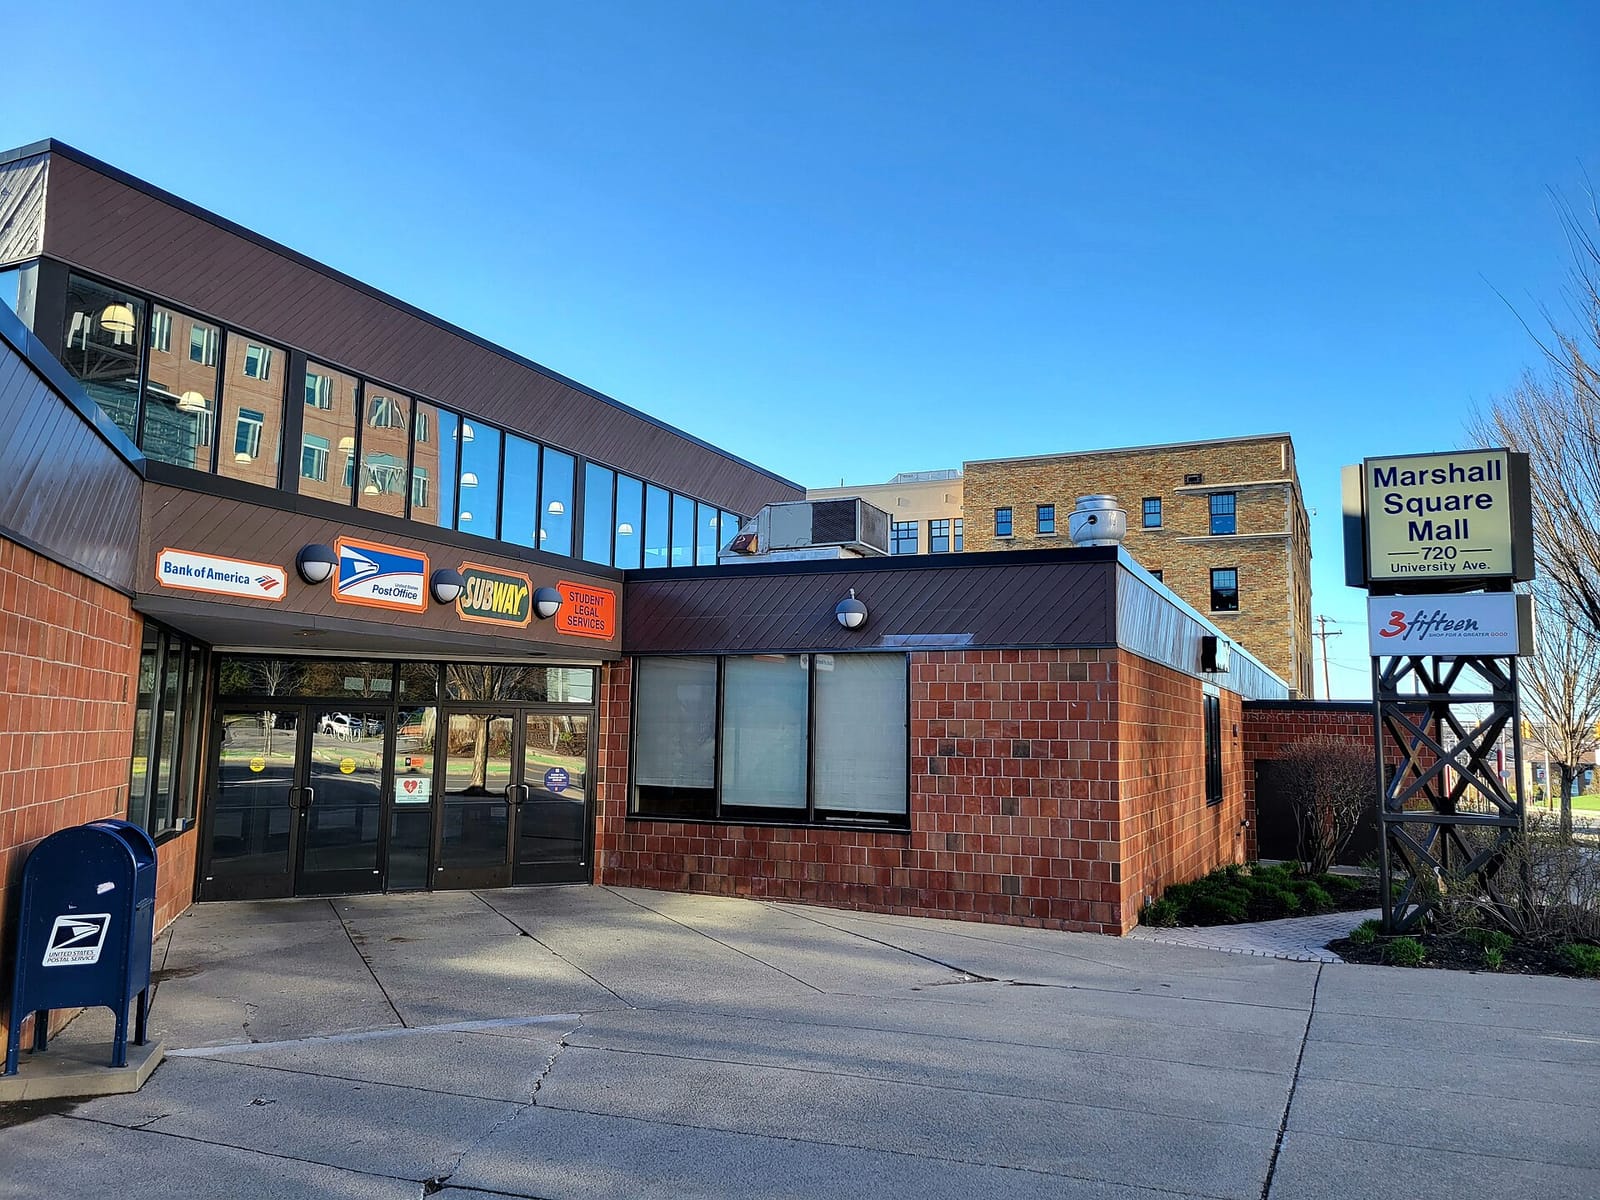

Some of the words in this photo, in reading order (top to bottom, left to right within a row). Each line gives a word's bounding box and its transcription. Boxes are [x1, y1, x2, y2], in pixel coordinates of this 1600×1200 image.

[1374, 460, 1501, 488] Marshall
[1384, 491, 1493, 517] Square
[1408, 518, 1469, 542] Mall
[1421, 546, 1457, 560] 720
[164, 561, 193, 577] Bank
[194, 567, 206, 578] of
[206, 567, 250, 584] America
[1391, 561, 1456, 573] University
[1462, 560, 1490, 570] Ave.
[372, 584, 392, 596] Post
[392, 587, 418, 600] Office
[461, 576, 528, 616] SUBWAY
[569, 591, 605, 606] STUDENT
[574, 604, 599, 617] LEGAL
[567, 615, 605, 630] SERVICES
